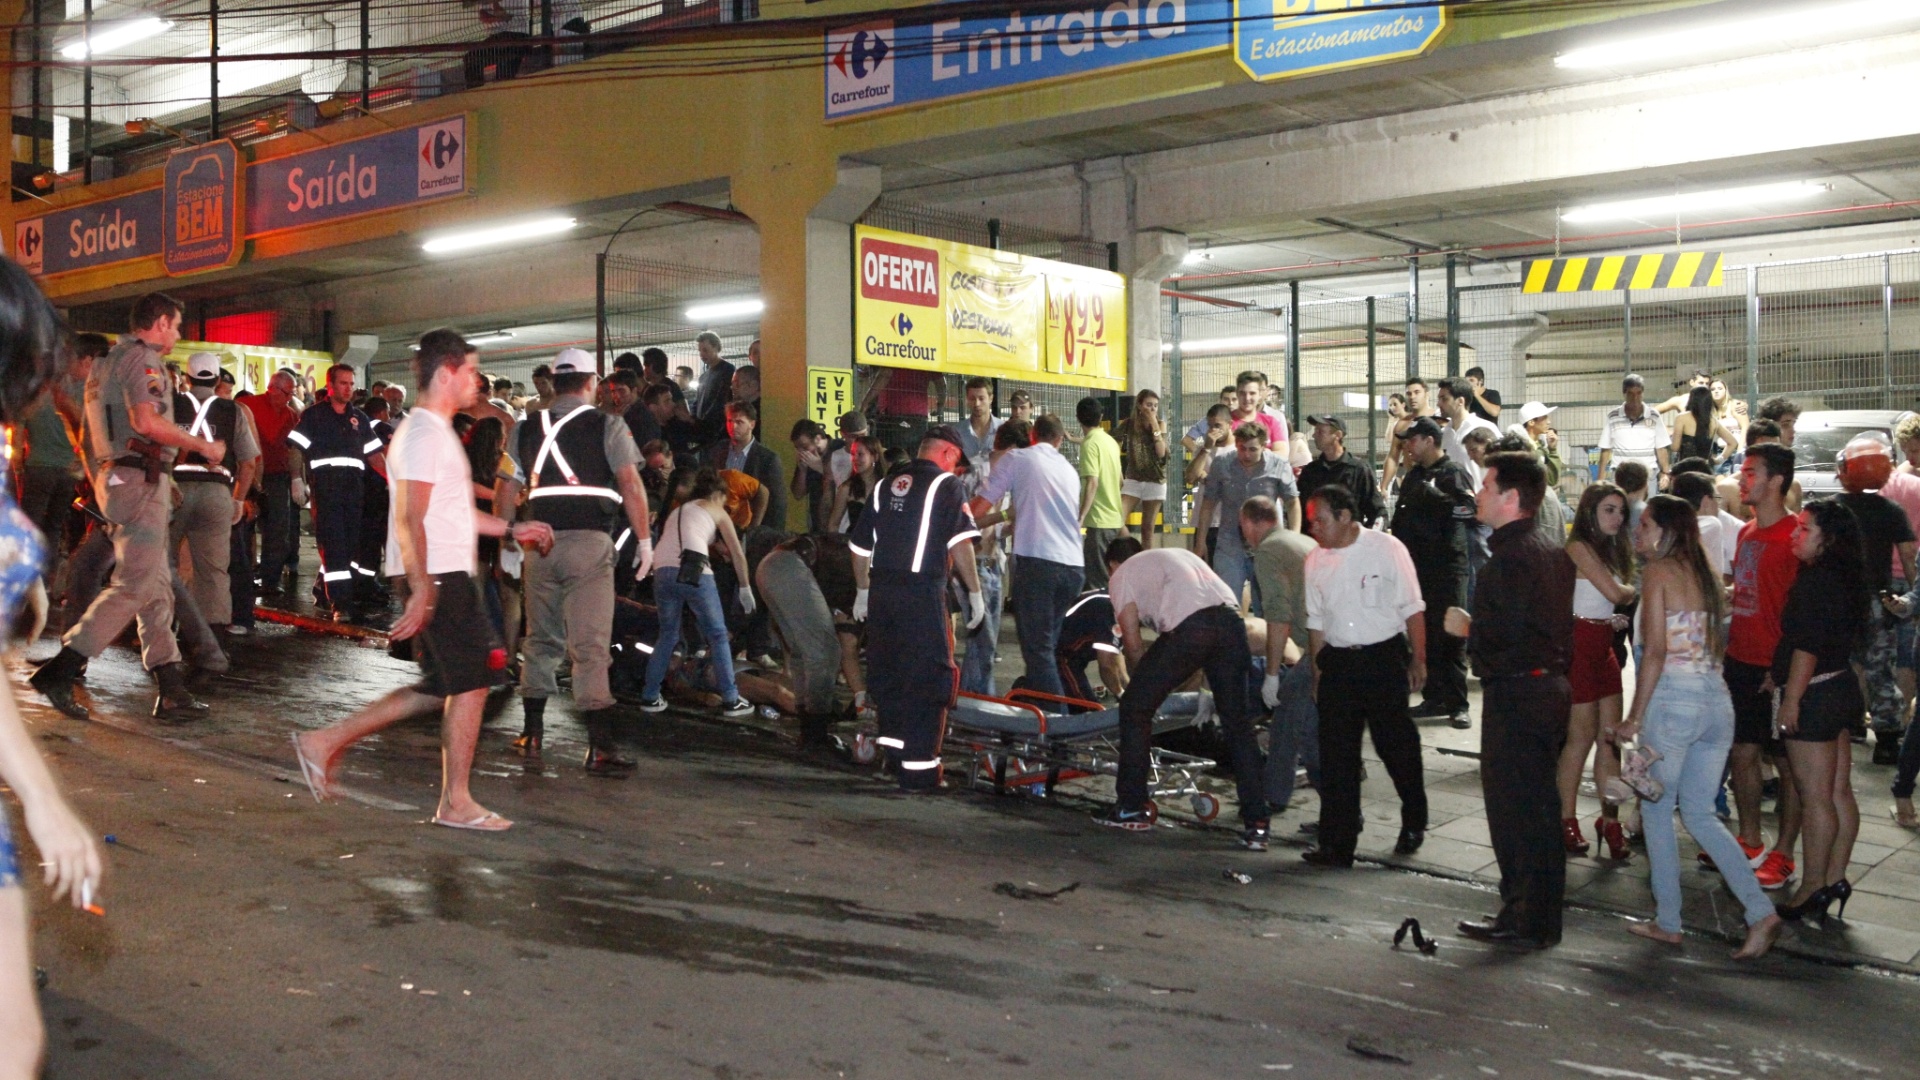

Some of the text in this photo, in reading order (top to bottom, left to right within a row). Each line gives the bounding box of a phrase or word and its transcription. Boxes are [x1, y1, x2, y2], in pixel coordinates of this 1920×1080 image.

[932, 0, 1186, 82] Entrada
[1250, 15, 1424, 61] Estacionamentos
[831, 84, 890, 105] Carrefour
[177, 184, 225, 204] Estacione
[287, 154, 377, 213] Saída
[420, 174, 460, 190] Carrefour
[69, 208, 137, 258] Saída
[176, 196, 223, 242] BEM
[864, 251, 937, 295] OFERTA
[865, 335, 937, 361] Carrefour
